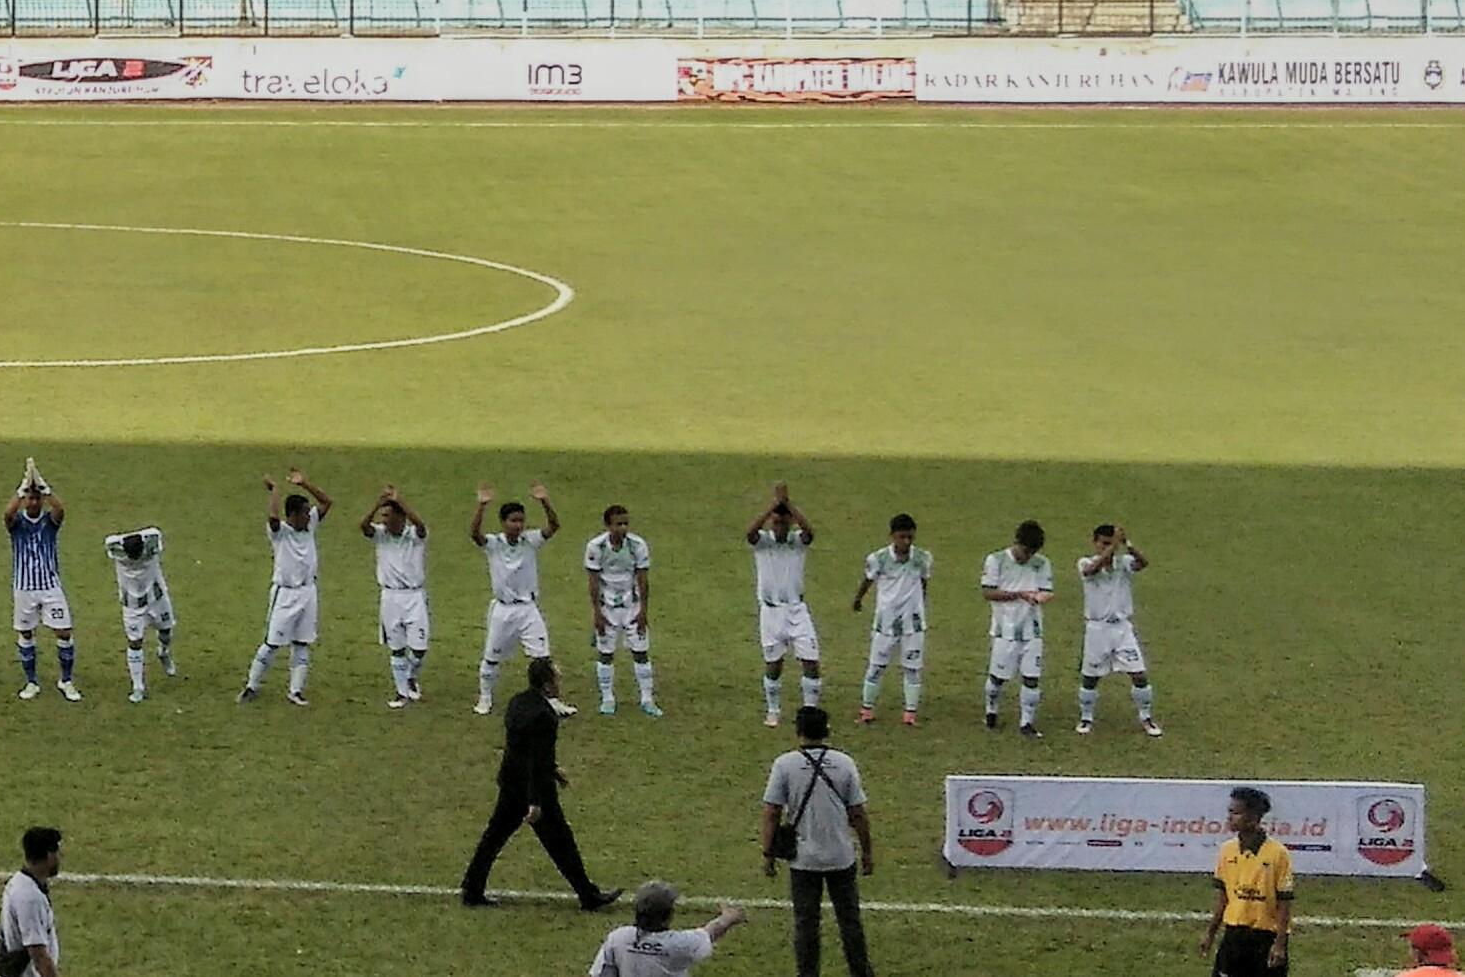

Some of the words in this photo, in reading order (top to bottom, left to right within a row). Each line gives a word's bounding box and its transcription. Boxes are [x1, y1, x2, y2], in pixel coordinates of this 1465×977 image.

[50, 60, 119, 79] LIGA
[1217, 62, 1279, 85] KAWULA
[1285, 62, 1328, 85] MUDA
[1334, 61, 1401, 85] BERSATU
[958, 829, 997, 838] LIGA
[1359, 837, 1397, 847] LIGA
